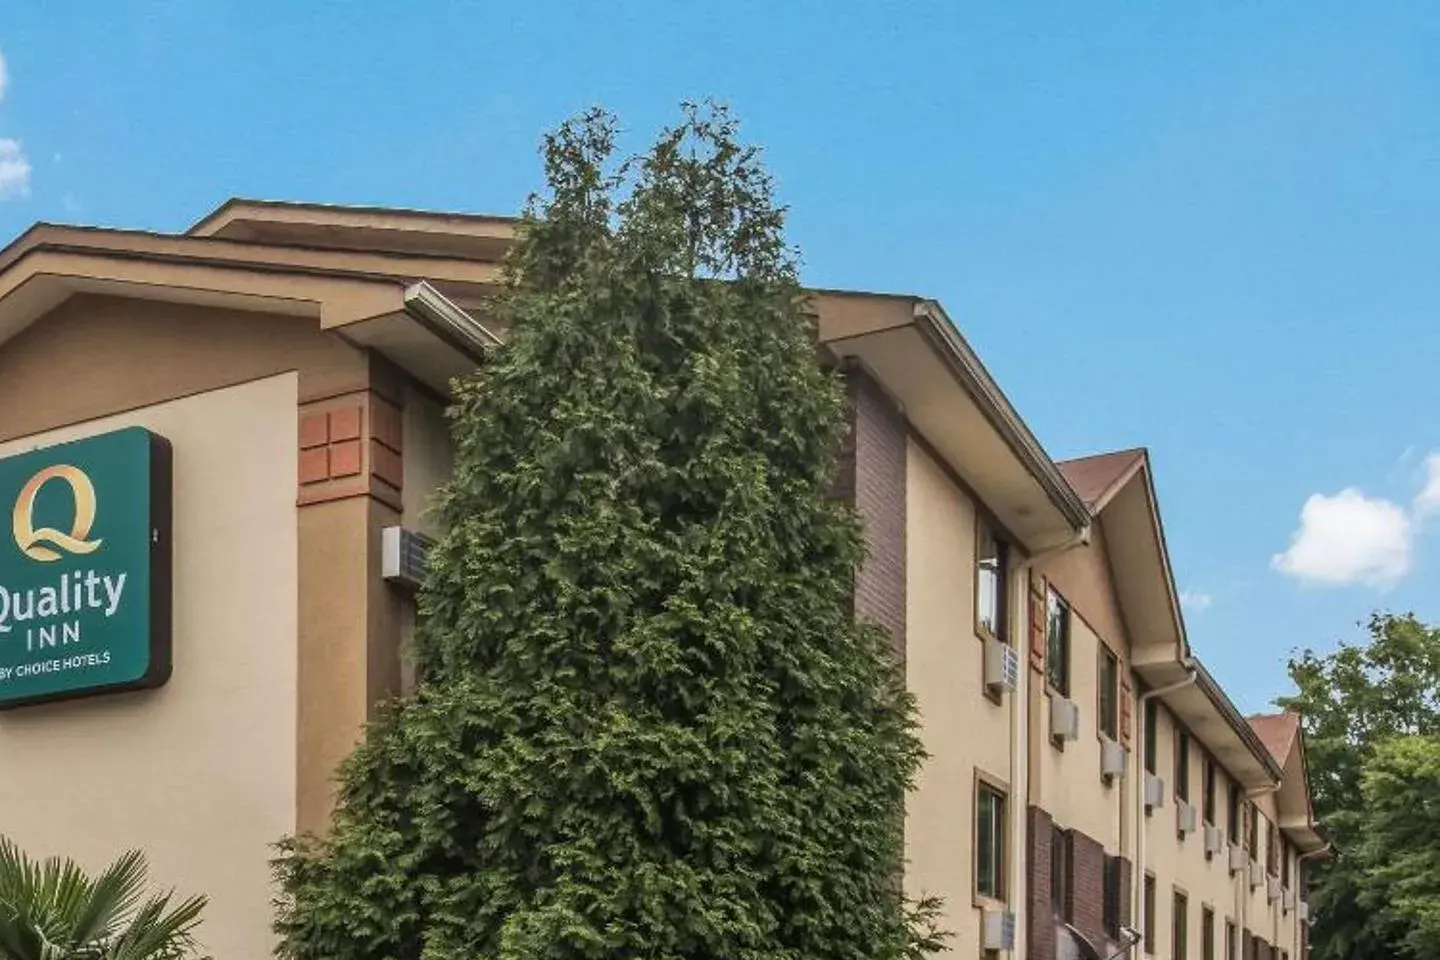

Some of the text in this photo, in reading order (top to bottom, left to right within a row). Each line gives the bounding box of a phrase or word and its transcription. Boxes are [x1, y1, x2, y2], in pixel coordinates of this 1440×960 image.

[13, 464, 103, 562] Q
[26, 620, 81, 651] INN
[15, 659, 61, 677] CHOICE
[62, 650, 111, 669] HOTELS
